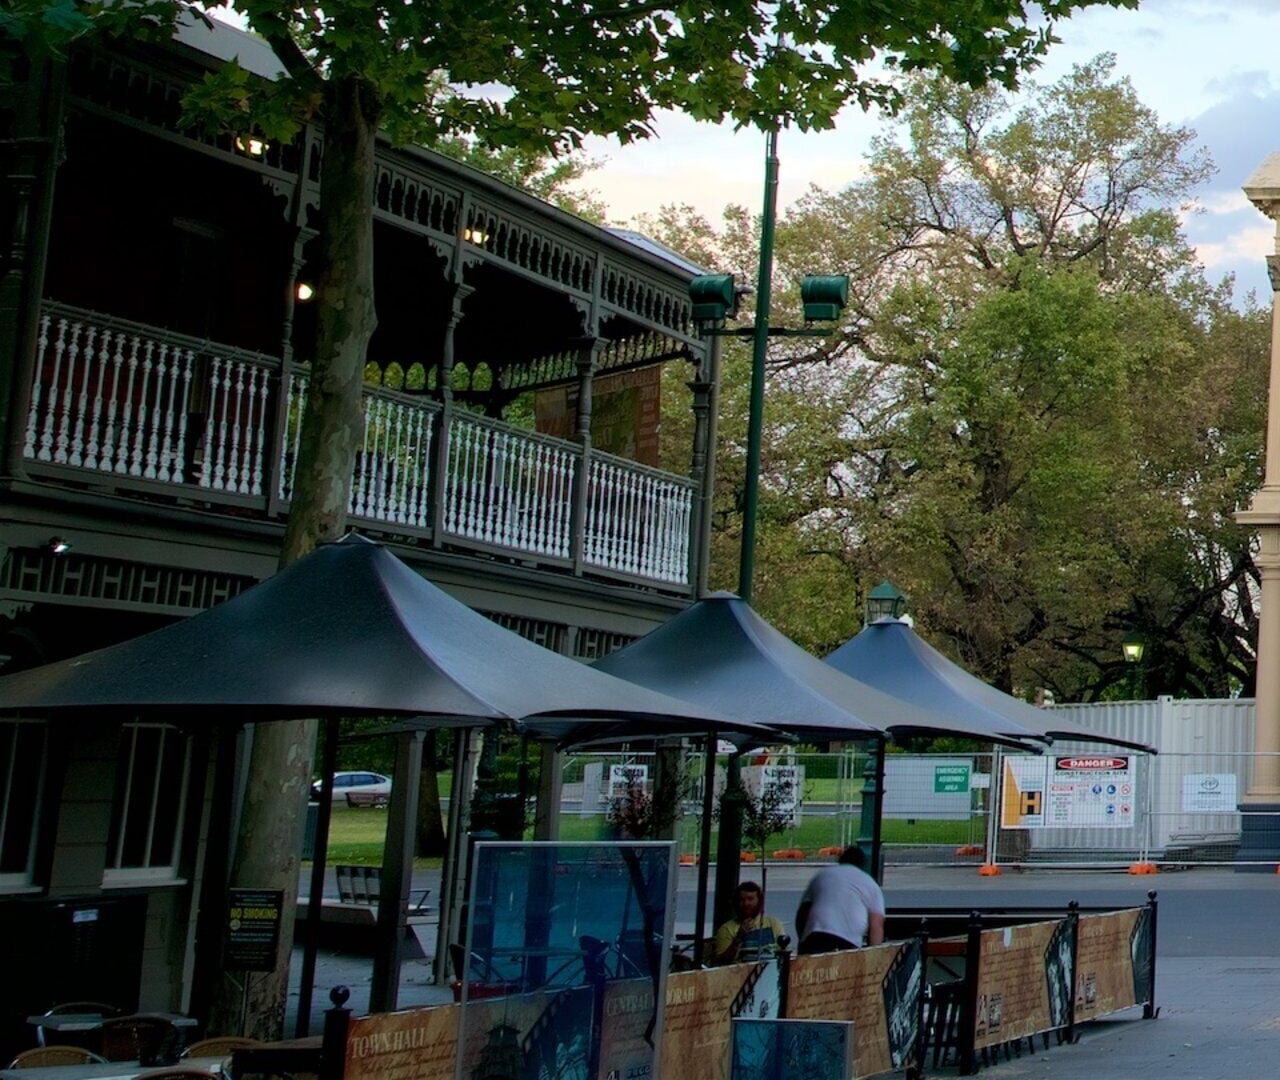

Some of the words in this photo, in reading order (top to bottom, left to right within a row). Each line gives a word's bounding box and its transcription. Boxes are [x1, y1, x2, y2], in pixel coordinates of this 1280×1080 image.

[1070, 759, 1114, 768] DANGER
[230, 907, 242, 919] NO
[243, 907, 278, 919] SMOKING
[351, 1032, 392, 1059] TOWN
[393, 1027, 426, 1051] HALL
